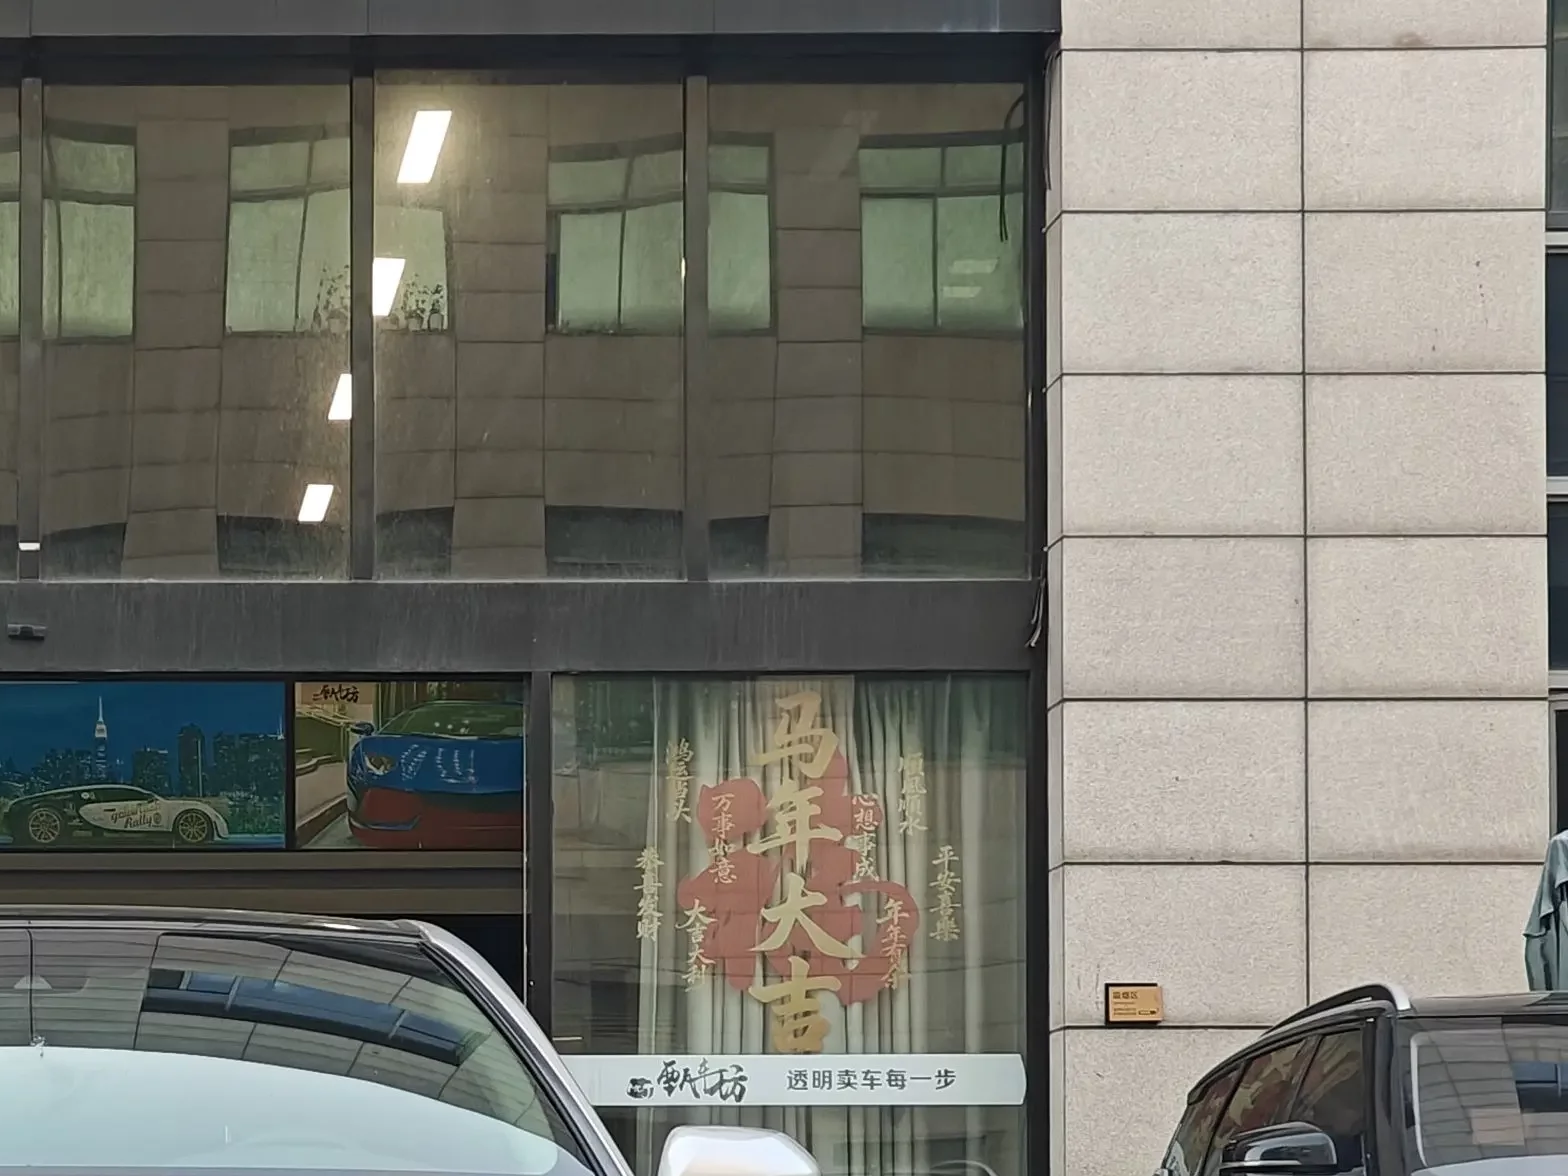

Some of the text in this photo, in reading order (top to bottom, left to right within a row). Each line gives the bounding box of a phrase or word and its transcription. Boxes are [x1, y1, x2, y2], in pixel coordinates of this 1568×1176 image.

[708, 792, 738, 885] 万事如意
[747, 691, 866, 1053] 马年大吉
[851, 793, 881, 883] 心想事成
[633, 845, 665, 942] 恭喜发财
[675, 898, 719, 993] 大吉大利
[786, 1067, 958, 1091] 透明卖车每一步
